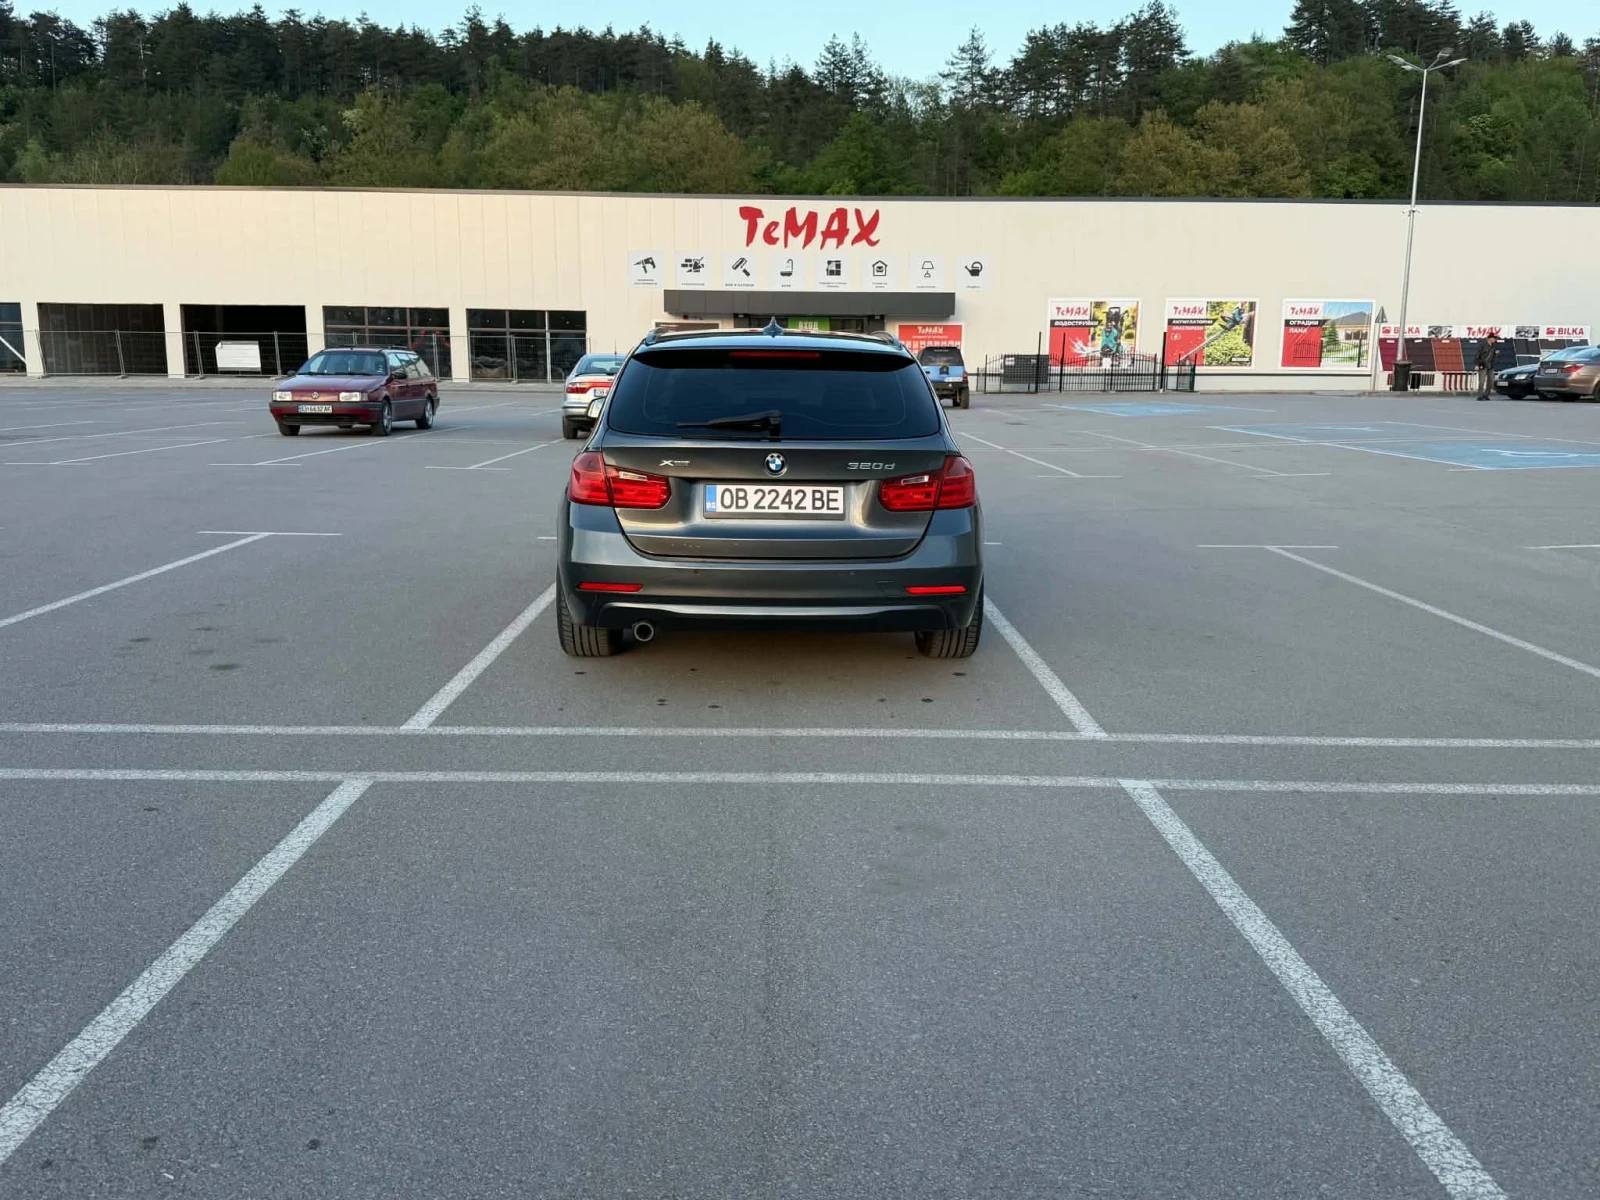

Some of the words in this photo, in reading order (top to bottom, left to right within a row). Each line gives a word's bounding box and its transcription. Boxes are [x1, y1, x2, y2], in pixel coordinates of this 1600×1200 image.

[1557, 327, 1584, 336] BILKA
[846, 462, 896, 470] 320d
[720, 487, 749, 510] OB
[753, 488, 807, 510] 2242
[811, 489, 840, 511] BE
